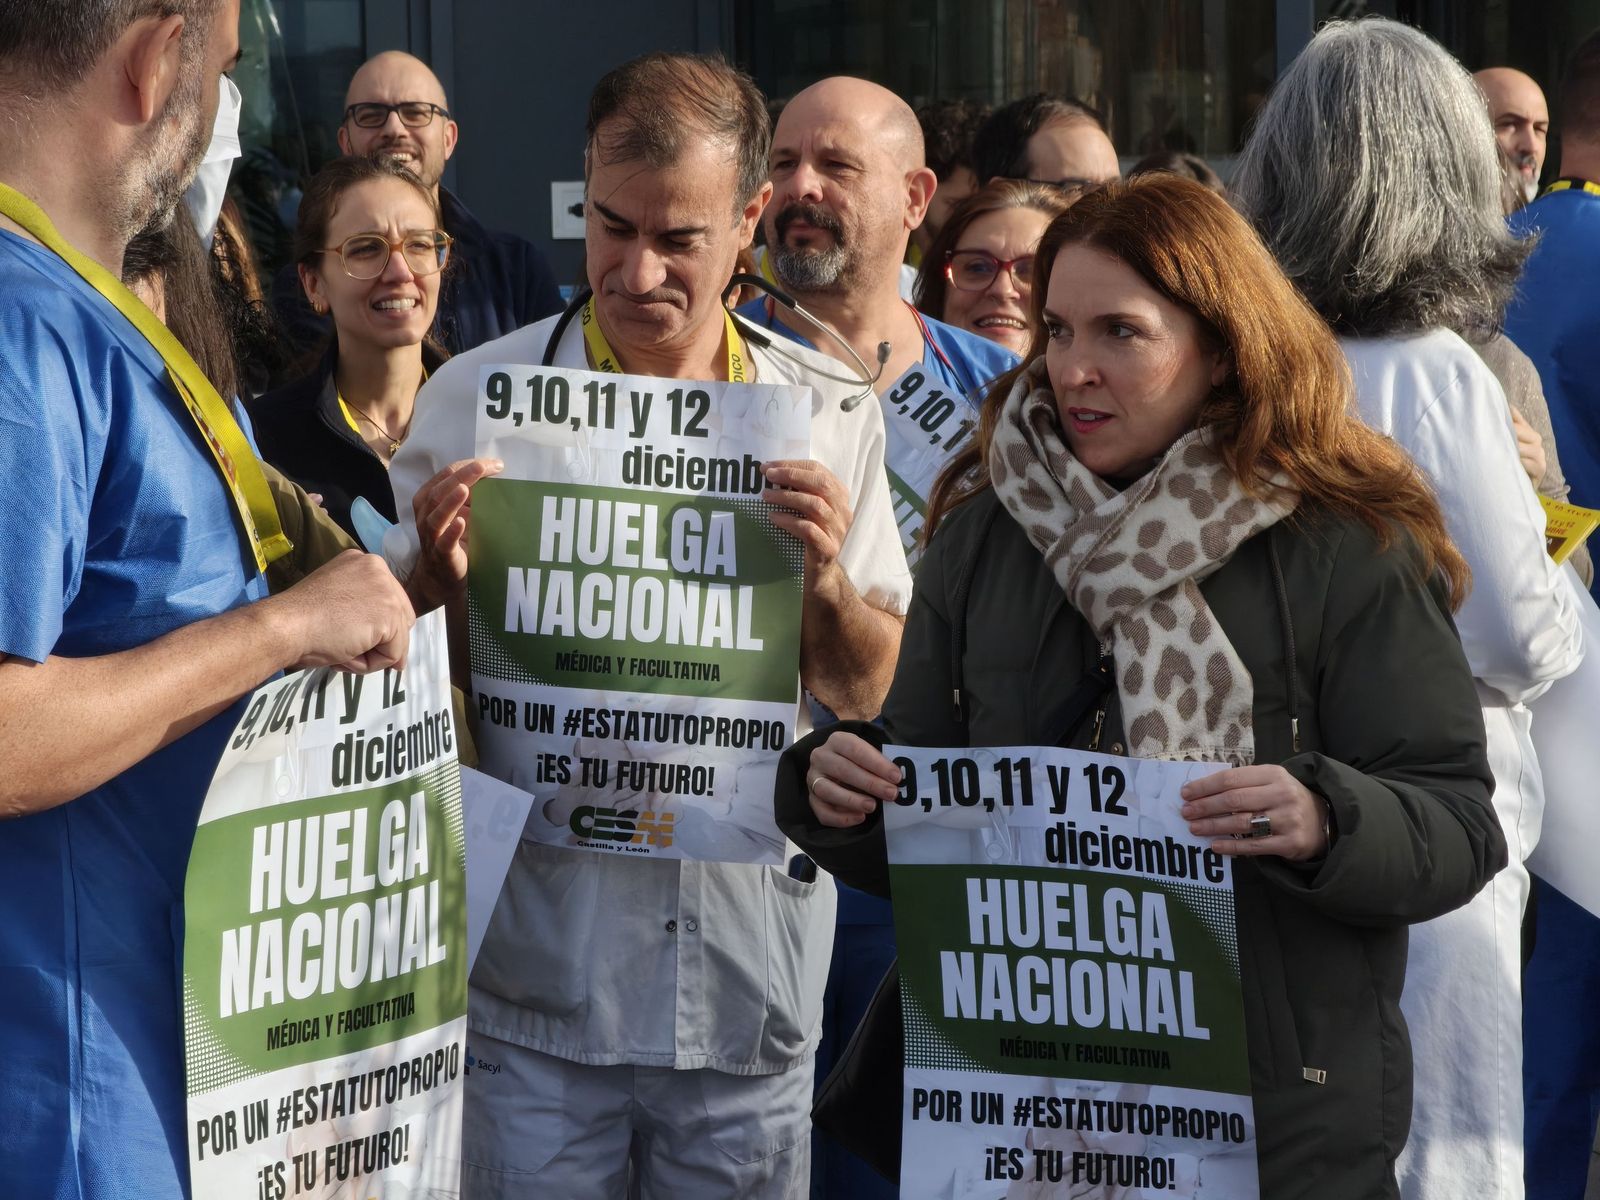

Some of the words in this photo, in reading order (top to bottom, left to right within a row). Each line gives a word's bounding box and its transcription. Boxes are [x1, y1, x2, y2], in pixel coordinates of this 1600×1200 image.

[731, 353, 745, 384] DICO
[485, 371, 616, 431] 9,10,11
[628, 390, 653, 438] y
[666, 388, 711, 438] 12
[622, 445, 797, 494] diciemb
[539, 495, 737, 577] HUELGA
[504, 566, 764, 651] NACIONAL
[555, 650, 612, 674] MÉDICA
[616, 657, 625, 675] Y
[629, 658, 721, 682] FACULTATIVA
[339, 671, 364, 725] y
[478, 692, 517, 729] POR
[524, 702, 555, 735] UN
[563, 708, 786, 751] #ESTATUTOPROPIO
[331, 708, 452, 788] diciembre
[536, 753, 572, 786] ¡ES
[580, 757, 608, 789] TU
[616, 760, 715, 796] FUTURO!
[891, 756, 1034, 812] 9,10,11
[1046, 764, 1070, 815] y
[1083, 763, 1128, 816] 12
[250, 790, 429, 914] HUELGA
[577, 840, 614, 851] Castilla
[616, 845, 623, 853] y
[625, 845, 650, 854] León
[1045, 821, 1225, 883] diciembre
[220, 879, 446, 1019] NACIONAL
[966, 877, 1175, 961] HUELGA
[266, 1016, 320, 1051] MÉDICA
[325, 1013, 333, 1038] Y
[337, 991, 415, 1036] FACULTATIVA
[940, 951, 1211, 1040] NACIONAL
[478, 1059, 501, 1075] Sacyl
[1000, 1034, 1057, 1060] MÉDICA
[1061, 1043, 1071, 1061] Y
[1075, 1043, 1171, 1070] FACULTATIVA
[197, 1110, 238, 1162] POR
[243, 1098, 269, 1145] UN
[276, 1041, 460, 1135] #ESTATUTOPROPIO
[912, 1088, 962, 1122] POR
[971, 1091, 1004, 1126] UN
[1013, 1095, 1245, 1144] #ESTATUTOPROPIO
[258, 1160, 286, 1200] ¡ES
[292, 1150, 316, 1194] TU
[324, 1124, 410, 1186] FUTURO!
[984, 1146, 1024, 1182] ¡ES
[1033, 1149, 1063, 1183] TU
[1072, 1151, 1176, 1190] FUTURO!
